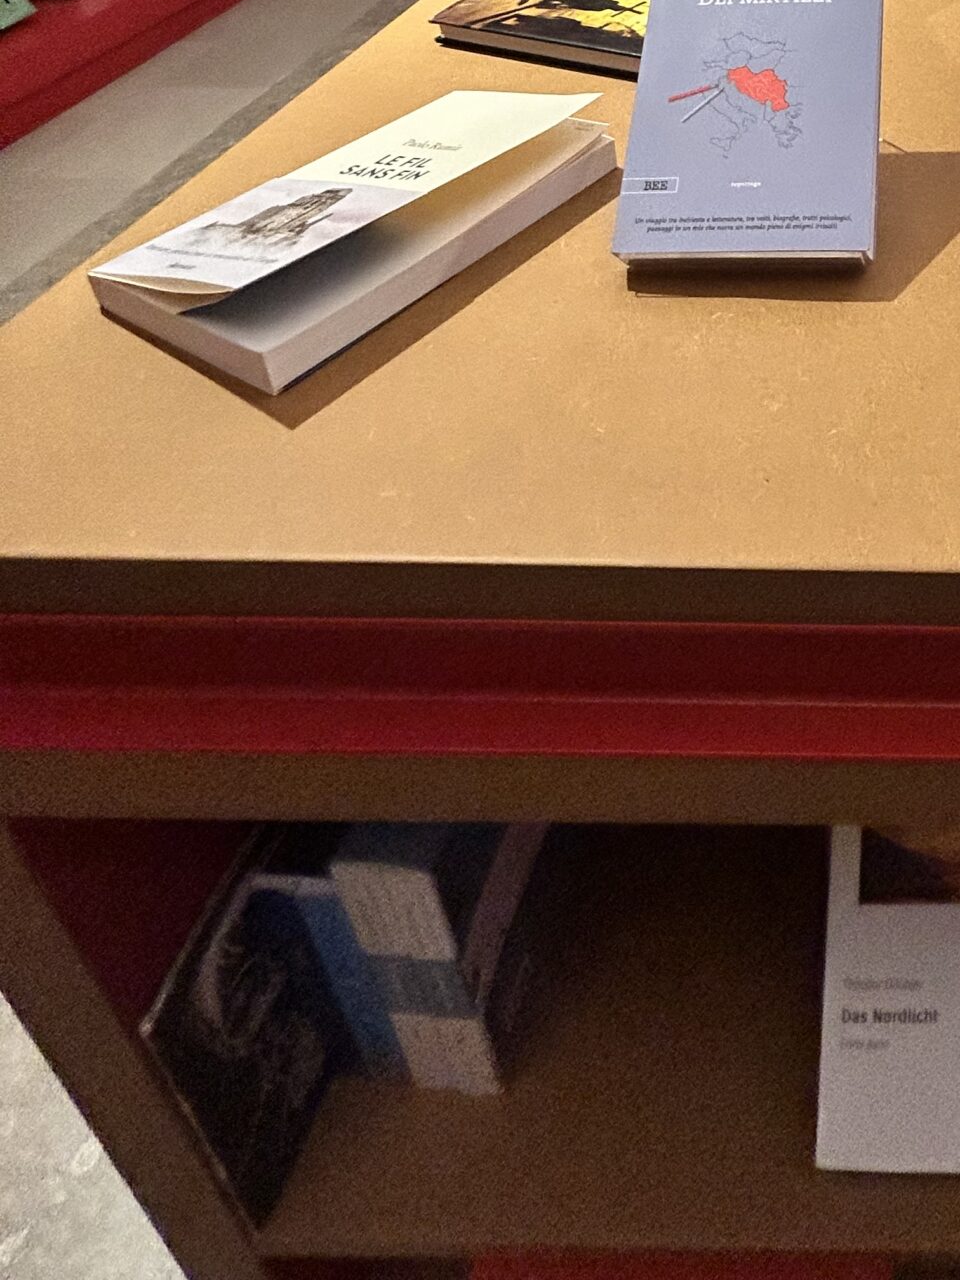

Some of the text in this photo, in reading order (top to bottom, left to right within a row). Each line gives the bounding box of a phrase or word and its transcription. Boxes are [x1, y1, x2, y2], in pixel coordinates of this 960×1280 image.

[374, 154, 433, 168] LE FIL
[339, 164, 431, 180] SANS FIN
[643, 180, 669, 191] BEE
[840, 1007, 942, 1024] Das Nordlicht
